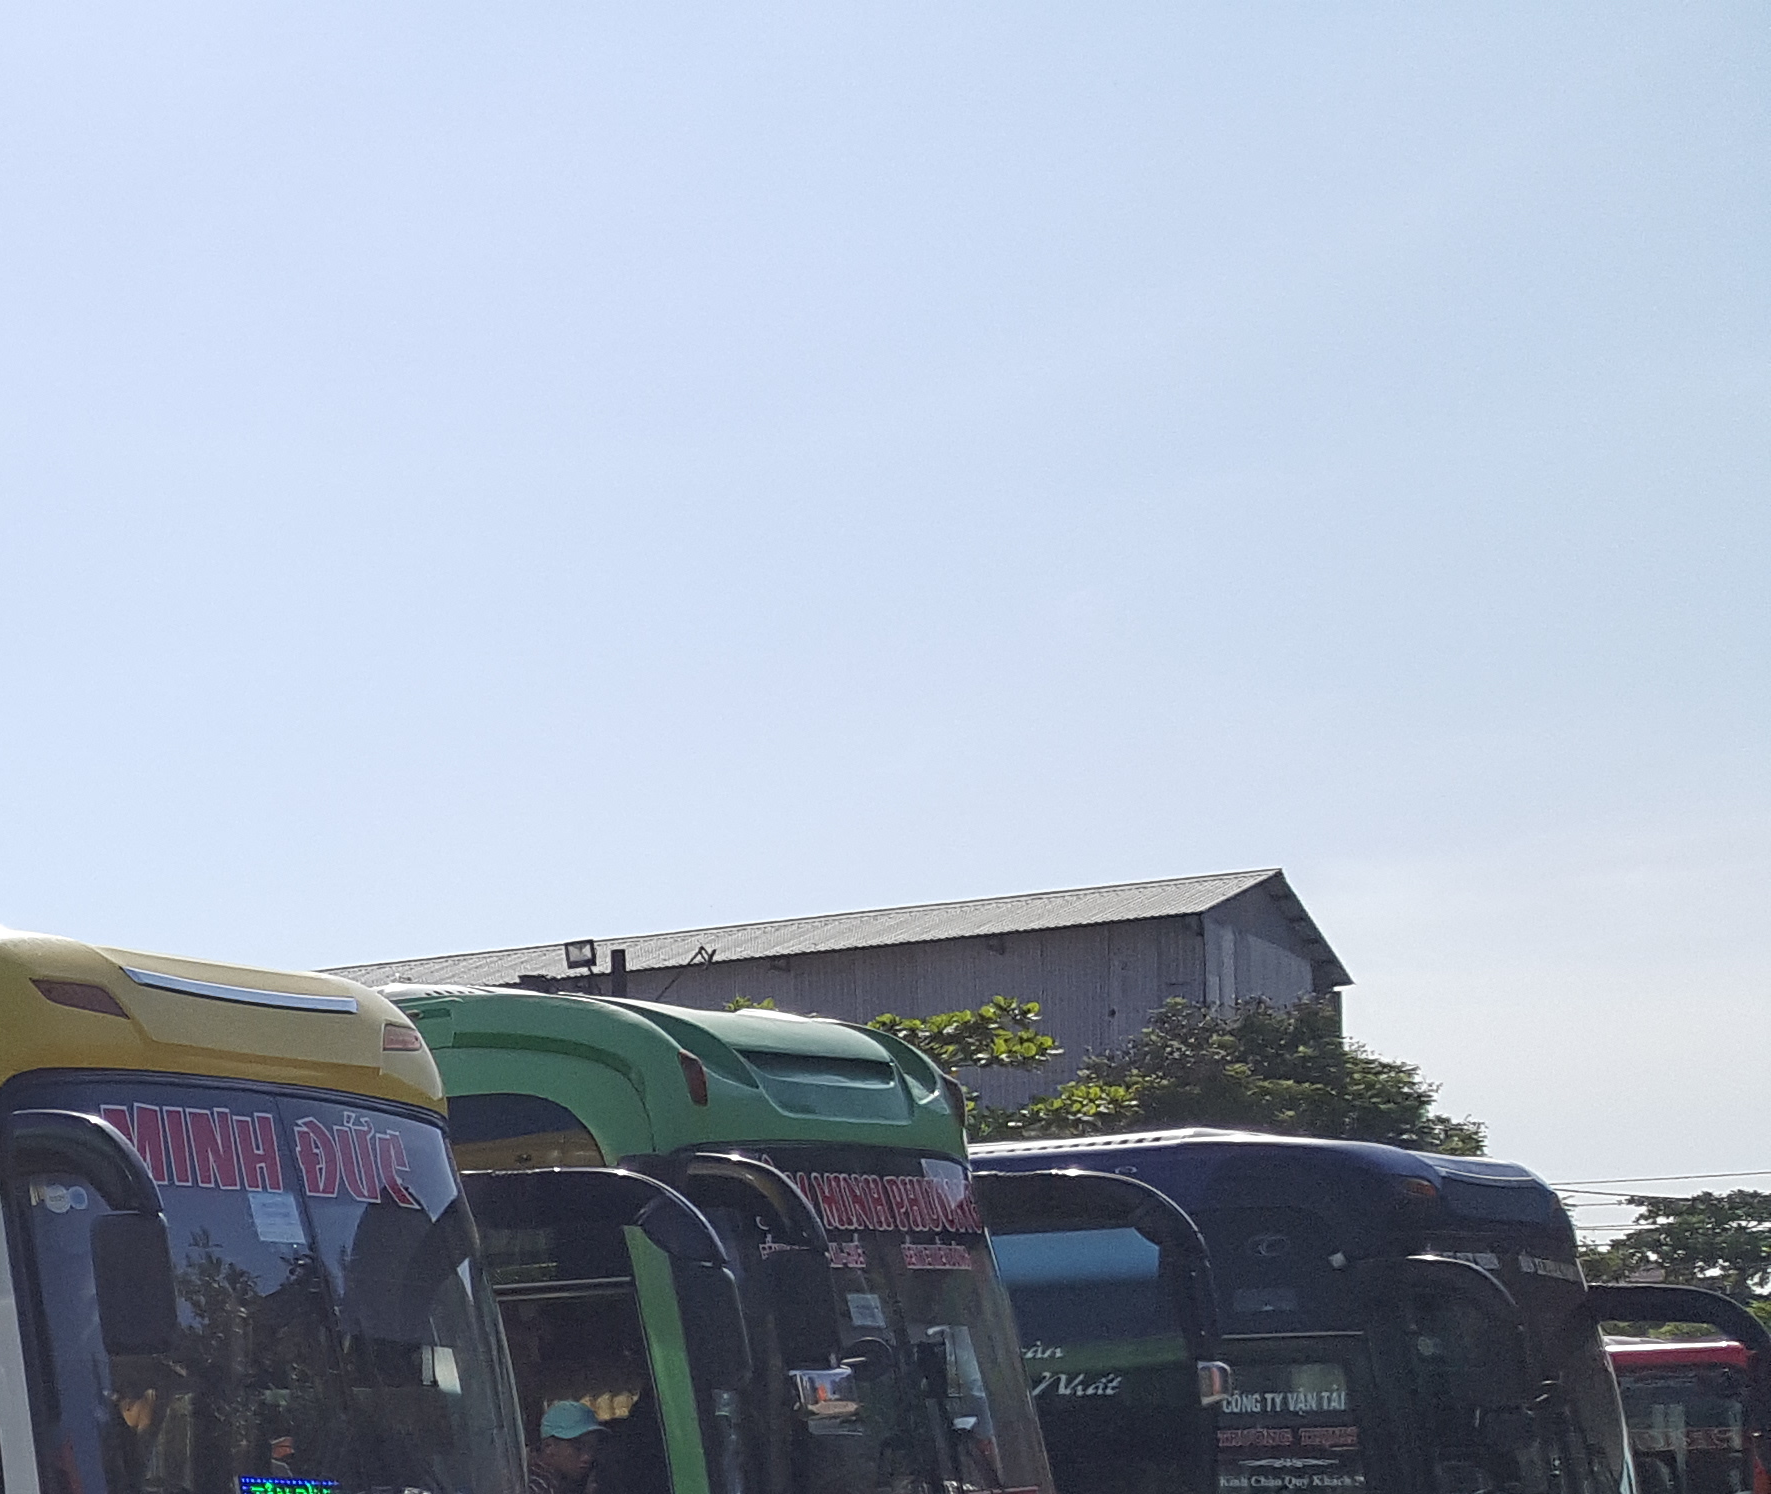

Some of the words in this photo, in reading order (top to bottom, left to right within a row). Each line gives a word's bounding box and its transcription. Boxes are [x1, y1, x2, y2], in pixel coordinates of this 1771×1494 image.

[99, 1102, 284, 1192] MINH
[294, 1111, 422, 1210] ĐỨC
[812, 1172, 895, 1231] MINH
[1223, 1391, 1261, 1413] CÔNG
[1264, 1393, 1284, 1411] TY
